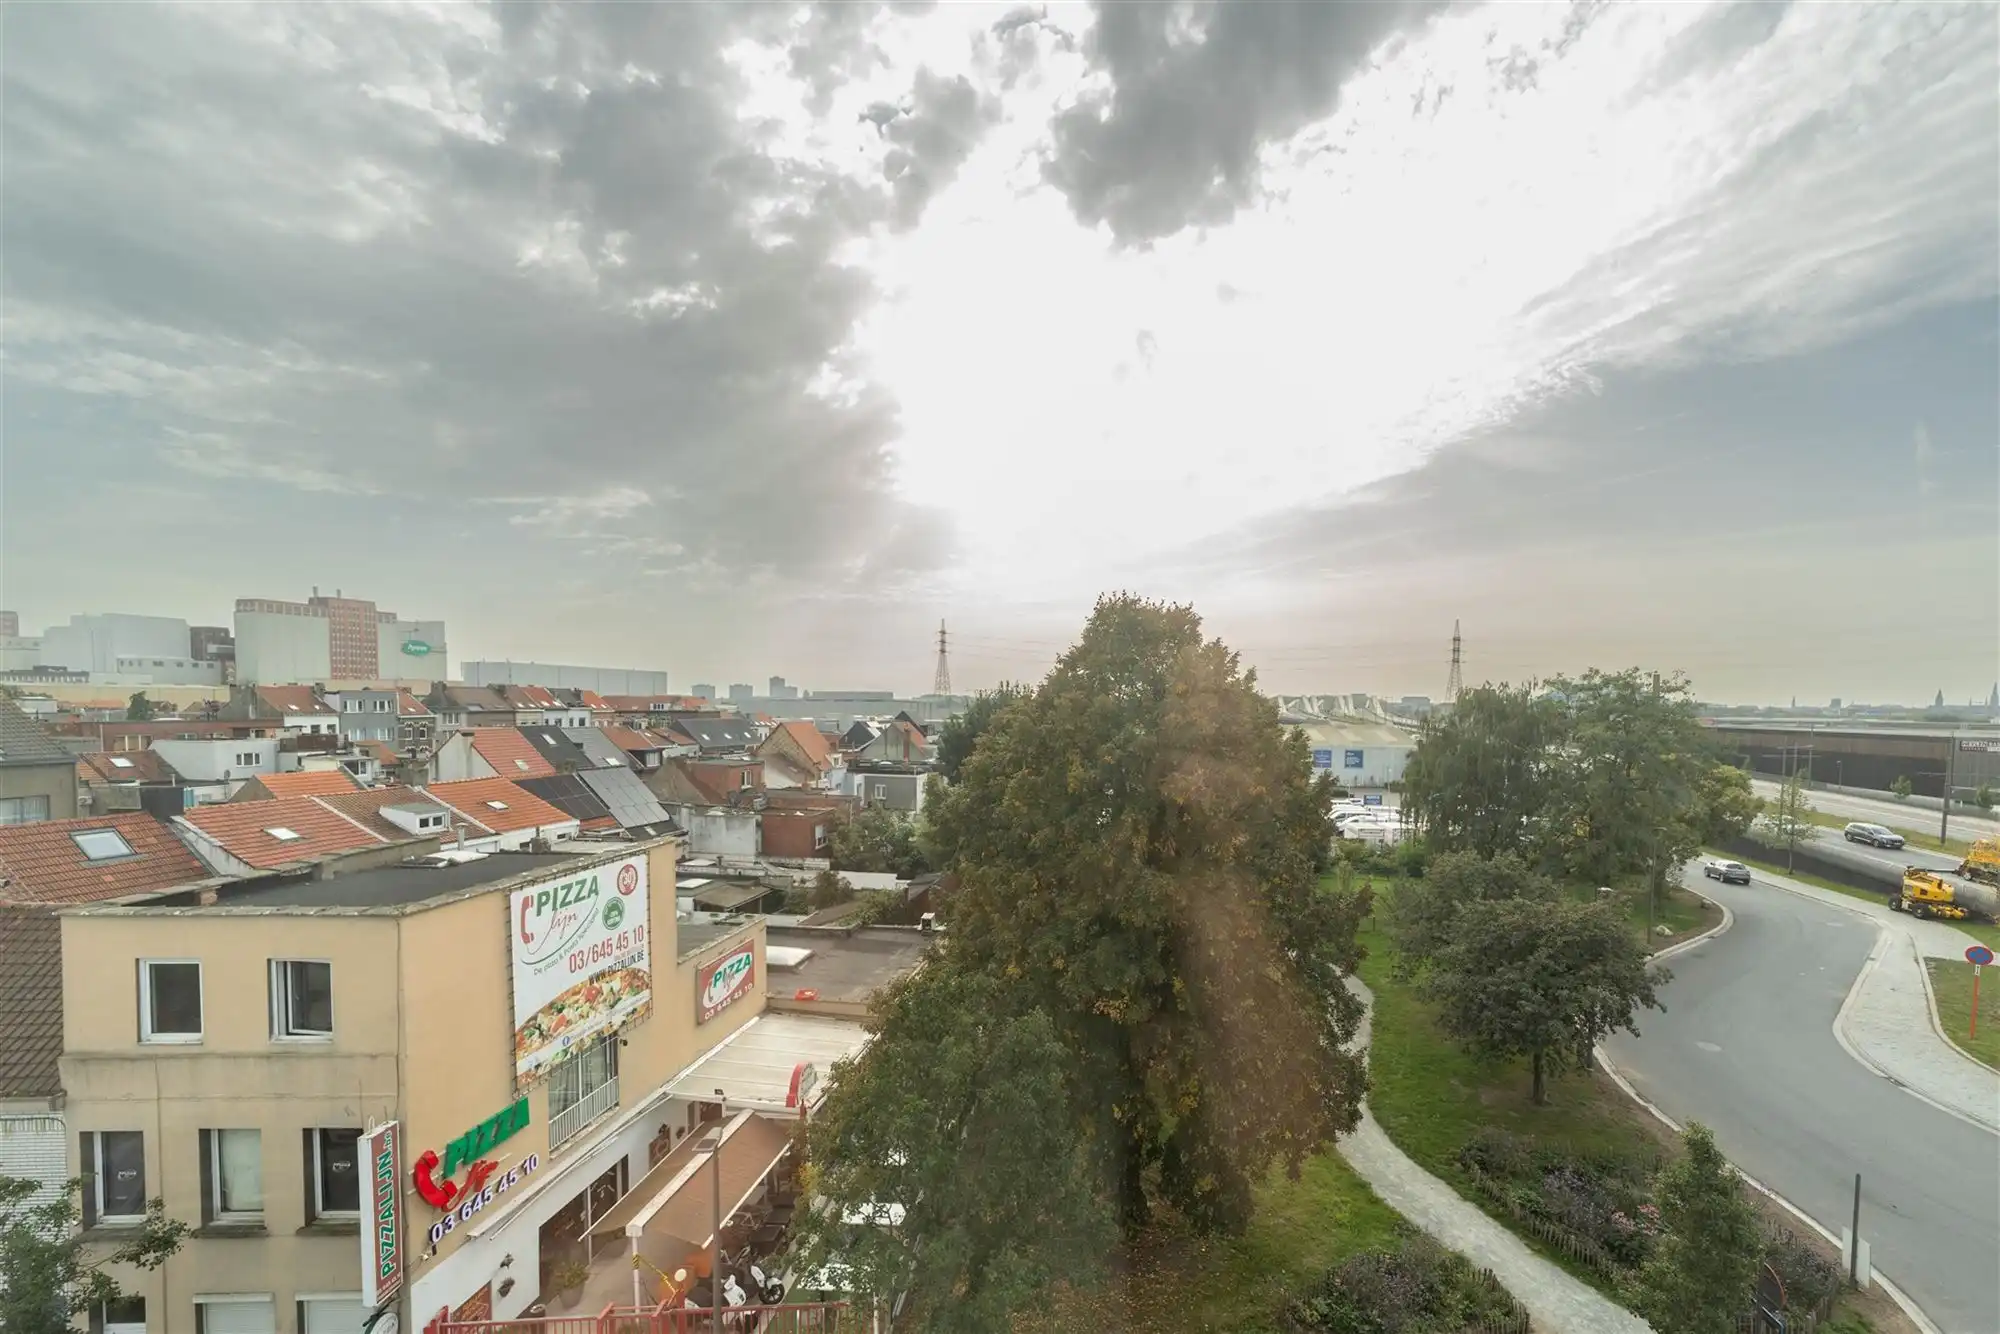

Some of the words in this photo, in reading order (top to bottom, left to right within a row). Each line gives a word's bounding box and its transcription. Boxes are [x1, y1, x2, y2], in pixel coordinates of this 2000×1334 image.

[536, 875, 599, 917] PIZZA
[569, 937, 613, 974] 03/645
[616, 930, 629, 952] 45
[633, 924, 644, 945] 10
[713, 954, 750, 987] PIZZA
[704, 1009, 714, 1020] 03
[744, 983, 753, 993] 10
[443, 1097, 530, 1178] PIZZA
[429, 1213, 455, 1243] 03
[459, 1185, 493, 1222] 645
[496, 1167, 518, 1193] 45
[522, 1153, 540, 1176] 10
